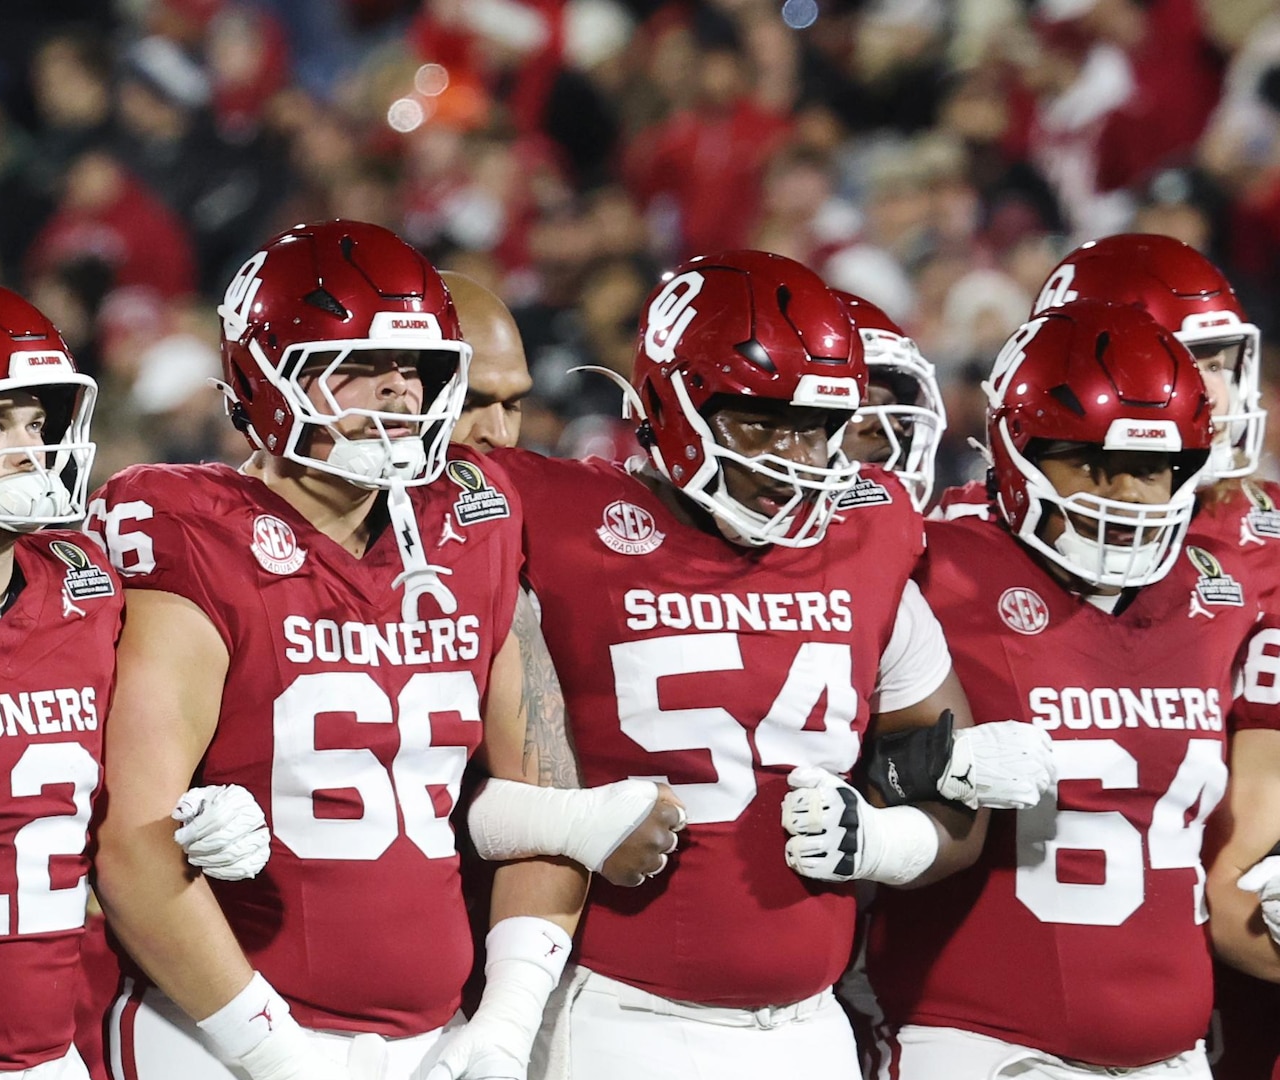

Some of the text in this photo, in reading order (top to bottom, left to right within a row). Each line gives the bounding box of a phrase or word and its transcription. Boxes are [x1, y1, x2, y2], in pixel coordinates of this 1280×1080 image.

[255, 516, 293, 560] SEC
[606, 502, 653, 540] SEC
[605, 534, 658, 554] GRADUATE
[624, 588, 853, 632] SOONERS
[1000, 589, 1046, 632] SEC
[282, 614, 480, 667] SOONERS
[608, 632, 863, 824] 54
[1028, 687, 1222, 731] SOONERS
[271, 670, 482, 861] 66
[1015, 738, 1229, 927] 64
